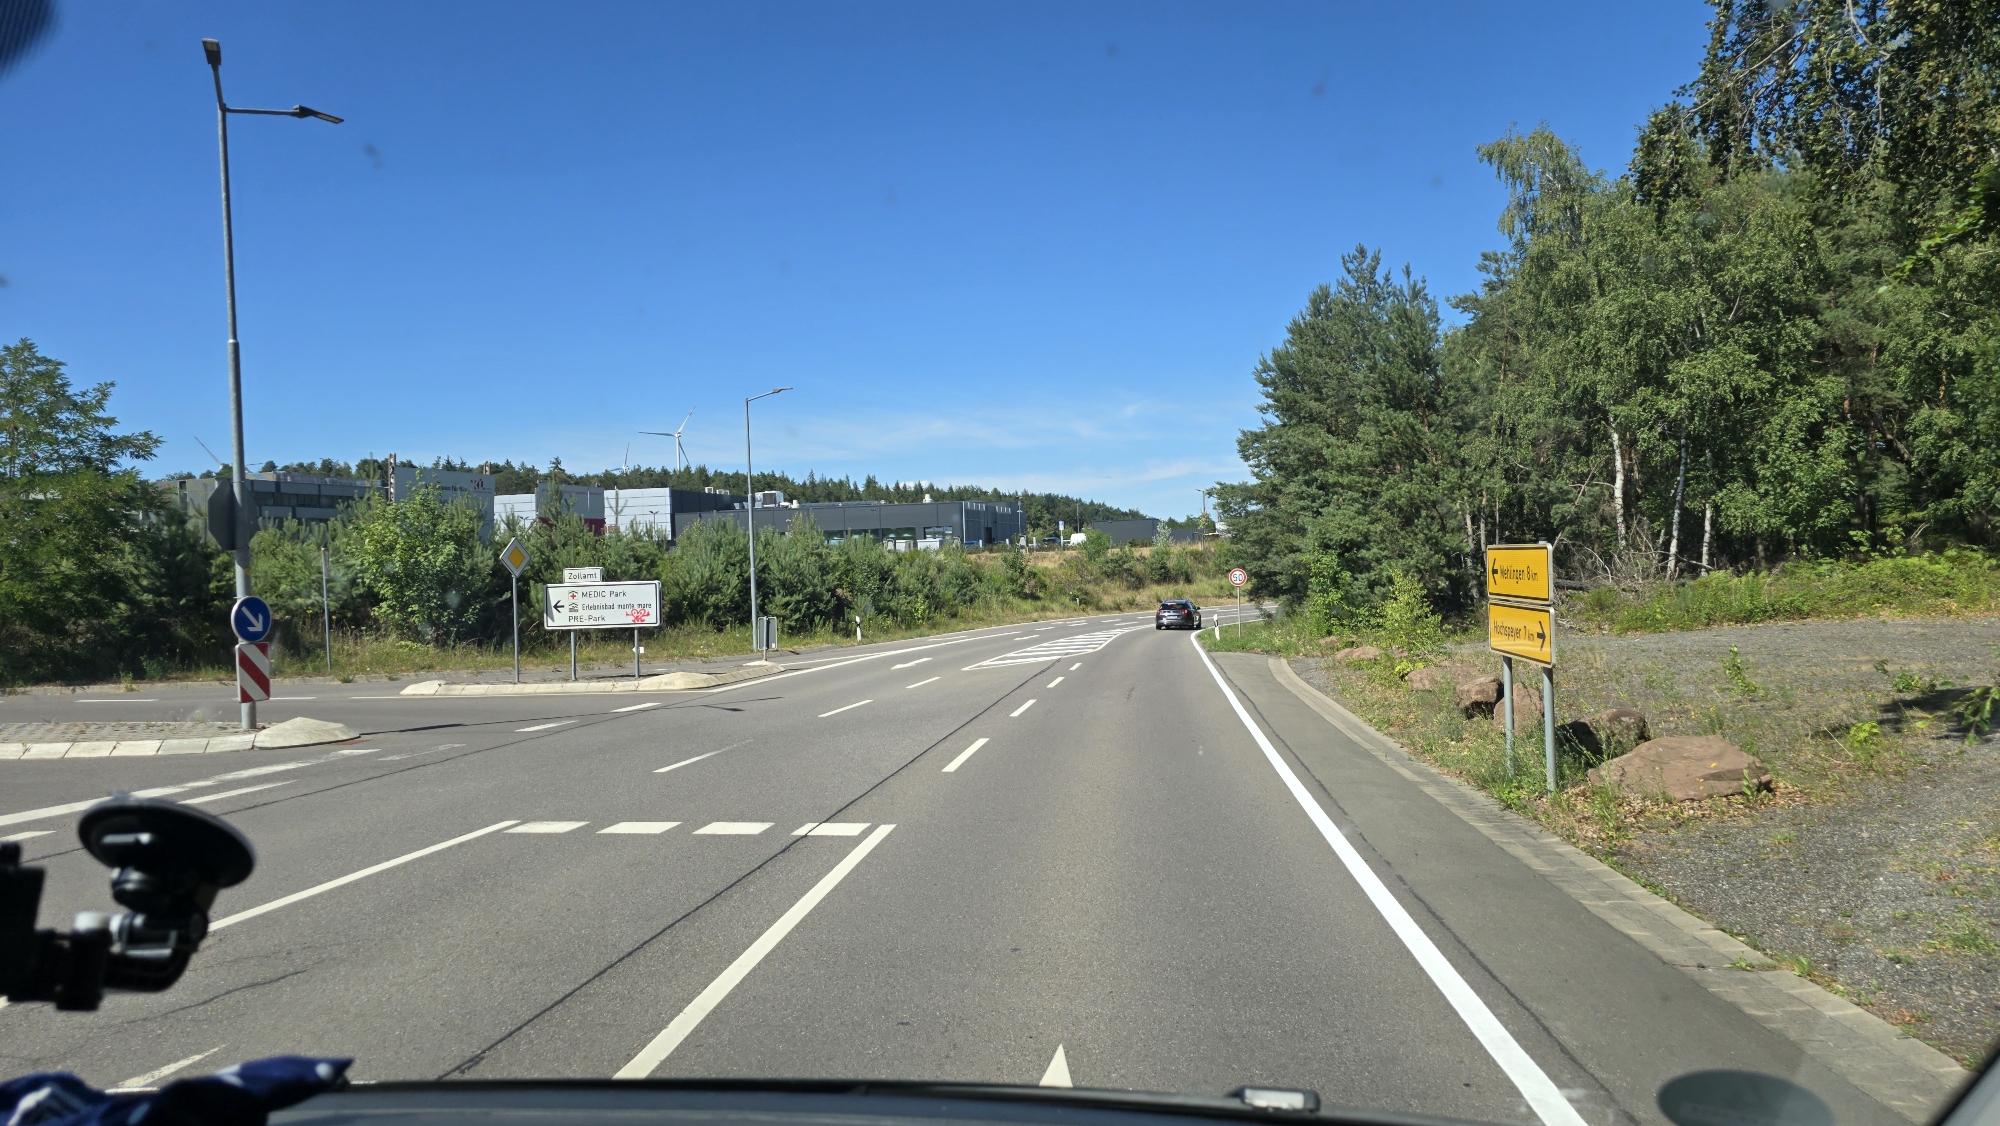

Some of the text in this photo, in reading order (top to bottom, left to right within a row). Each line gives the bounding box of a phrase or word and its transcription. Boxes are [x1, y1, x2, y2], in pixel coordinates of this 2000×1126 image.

[568, 572, 597, 580] Zollamt
[1233, 573, 1243, 582] 50
[581, 590, 627, 598] MEDIC Park
[581, 603, 615, 611] Erlebnisbad
[568, 615, 606, 623] PRE-Park
